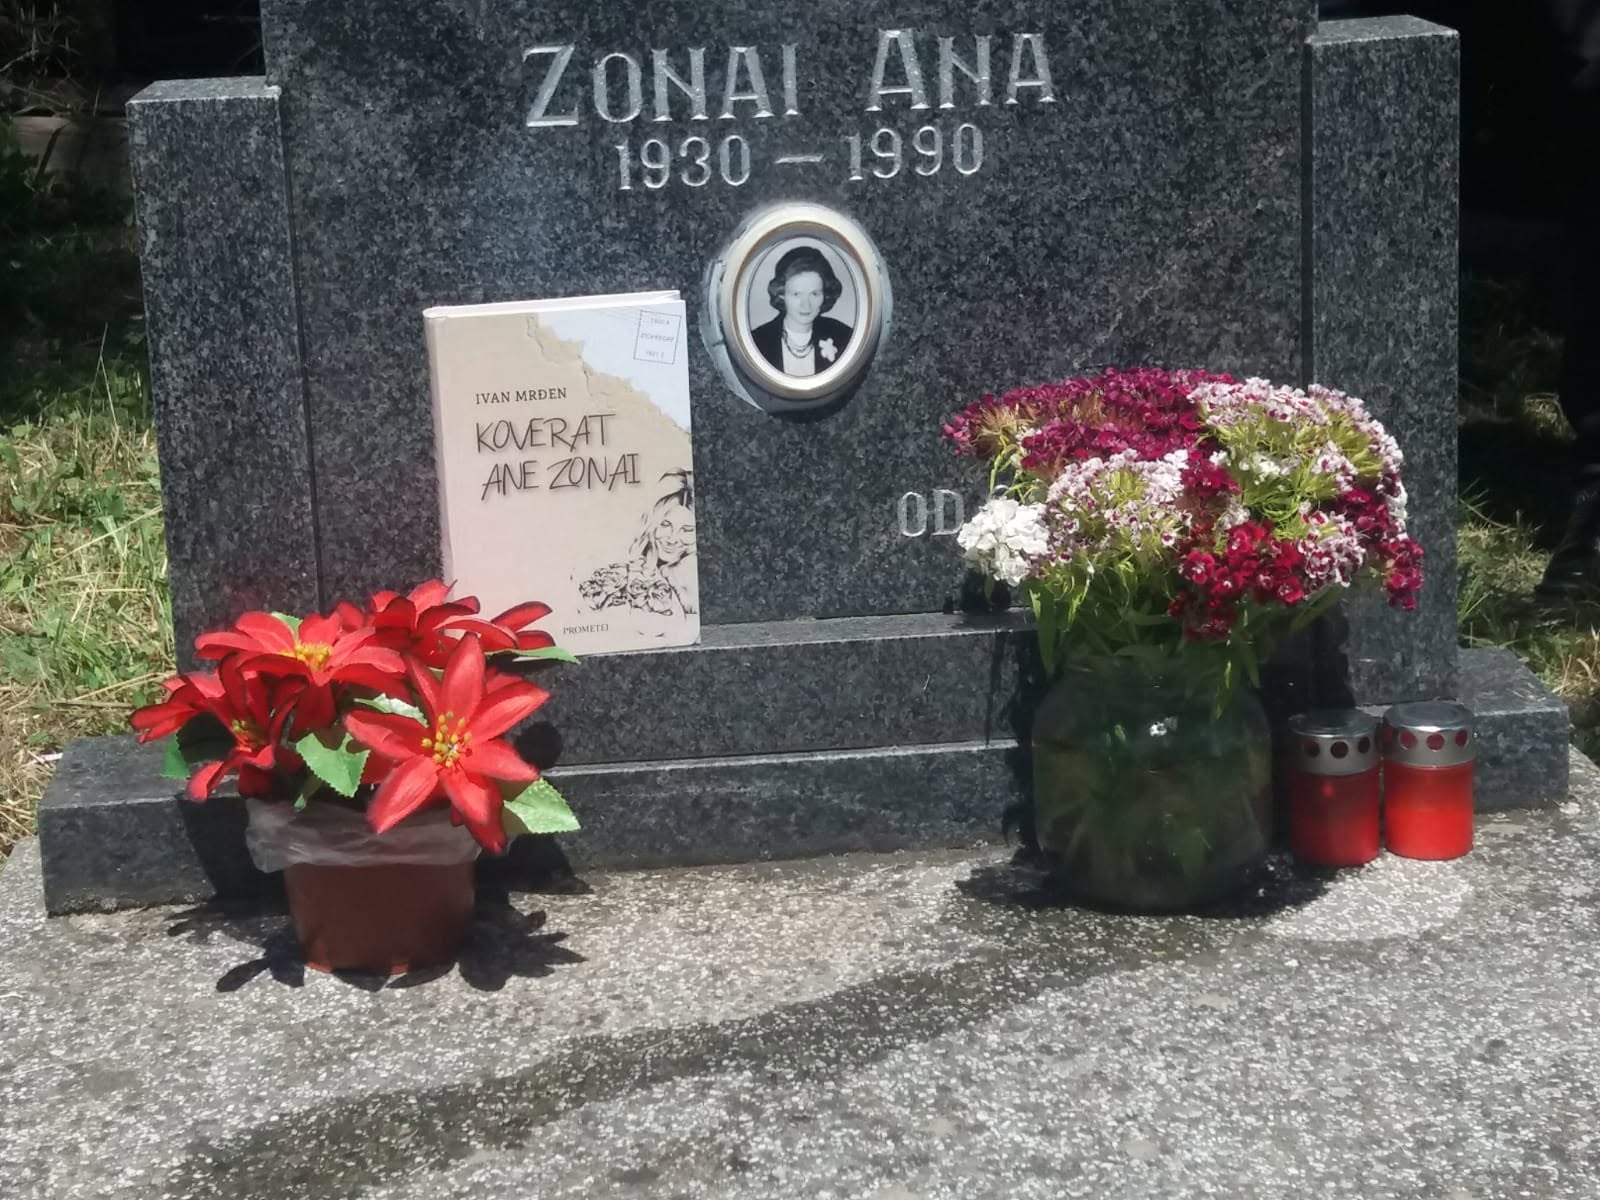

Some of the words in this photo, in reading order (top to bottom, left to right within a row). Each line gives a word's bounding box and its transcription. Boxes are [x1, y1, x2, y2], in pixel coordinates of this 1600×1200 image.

[524, 44, 799, 127] ZONAI
[866, 29, 1057, 111] ANA
[615, 135, 751, 190] 1930
[845, 123, 984, 181] 1990
[476, 391, 511, 405] IVAN
[515, 387, 568, 403] MRĐEN
[475, 413, 617, 453] KOVERAT
[480, 460, 540, 501] ANE
[546, 453, 642, 492] ZONAI
